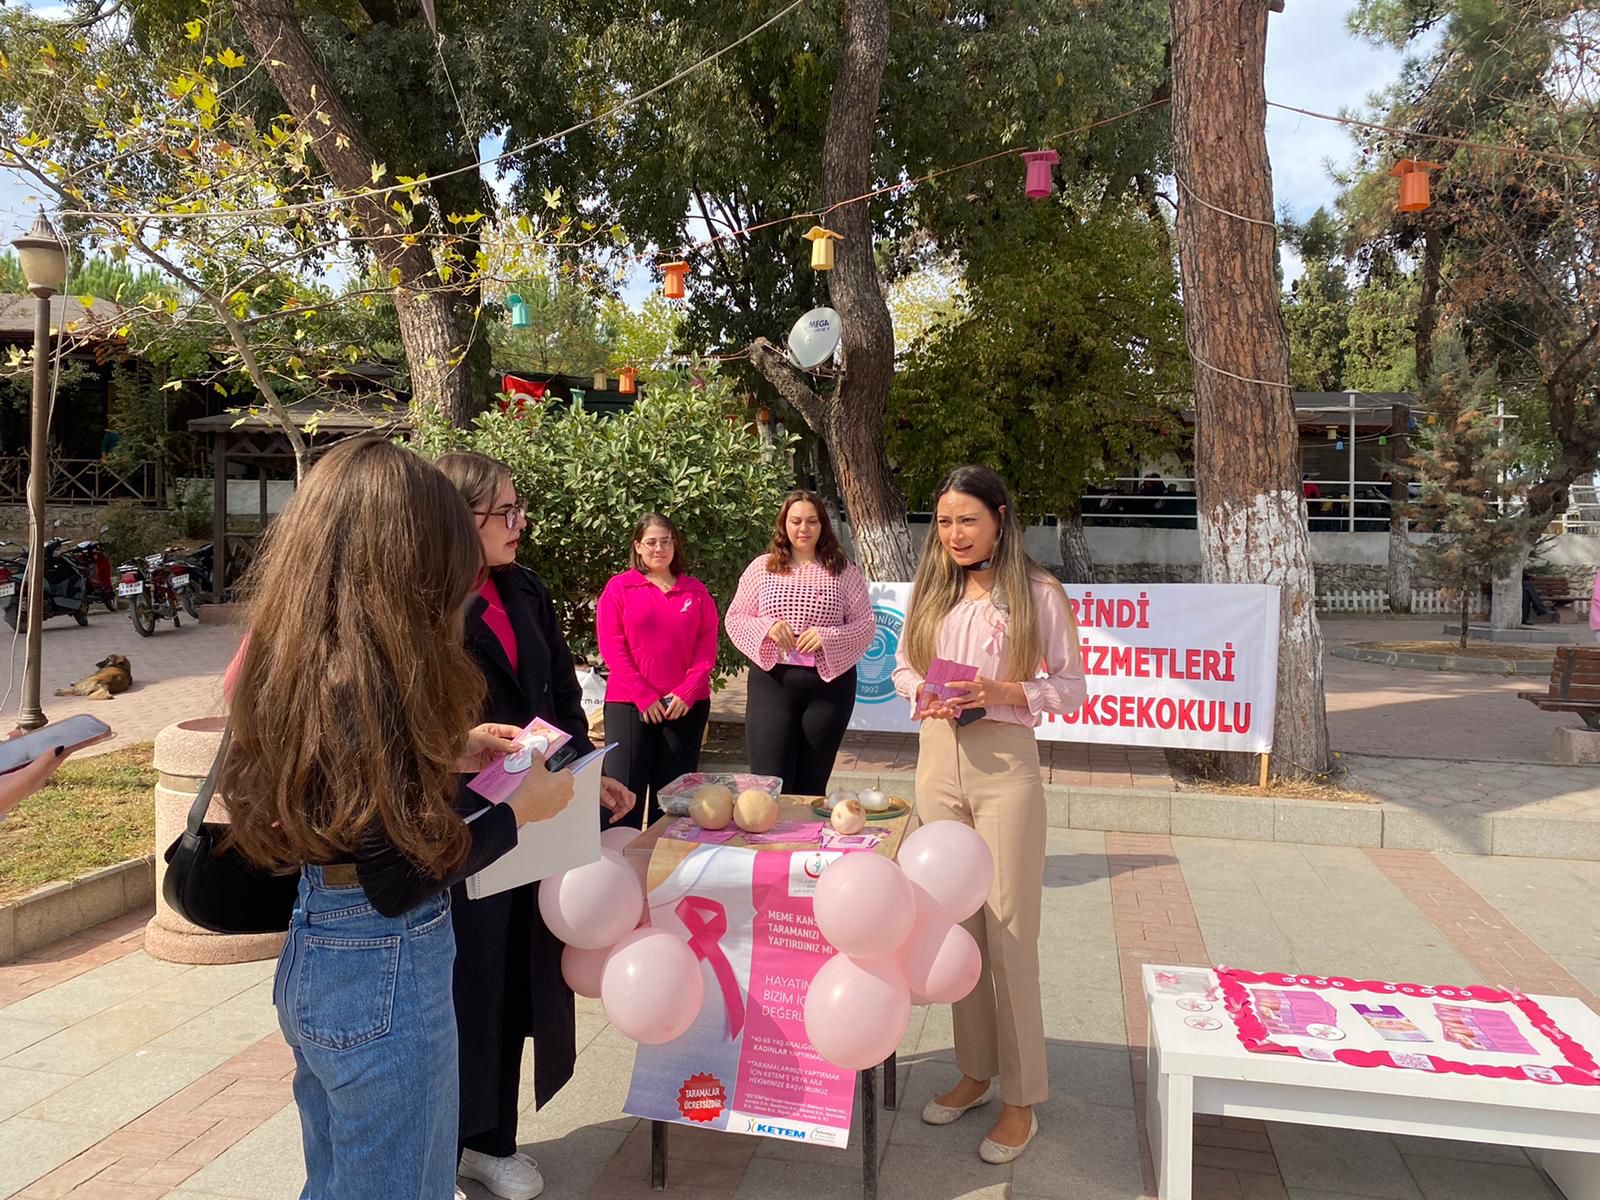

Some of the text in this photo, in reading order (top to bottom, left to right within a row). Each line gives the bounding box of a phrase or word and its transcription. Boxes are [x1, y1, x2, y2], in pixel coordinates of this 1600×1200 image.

[808, 319, 830, 329] MEGA
[1080, 637, 1236, 682] İZMETLERİ
[861, 685, 880, 694] 1992
[768, 910, 794, 923] MEME
[768, 923, 820, 940] TARAMANIZI
[768, 935, 820, 953] YAPTIRDINIZ
[772, 1038, 784, 1047] YAŞ
[753, 1044, 788, 1055] KADINLAR
[804, 1070, 841, 1081] YAPTIRMAK
[685, 1087, 720, 1098] TARAMALAR
[757, 1123, 806, 1139] KETEM
